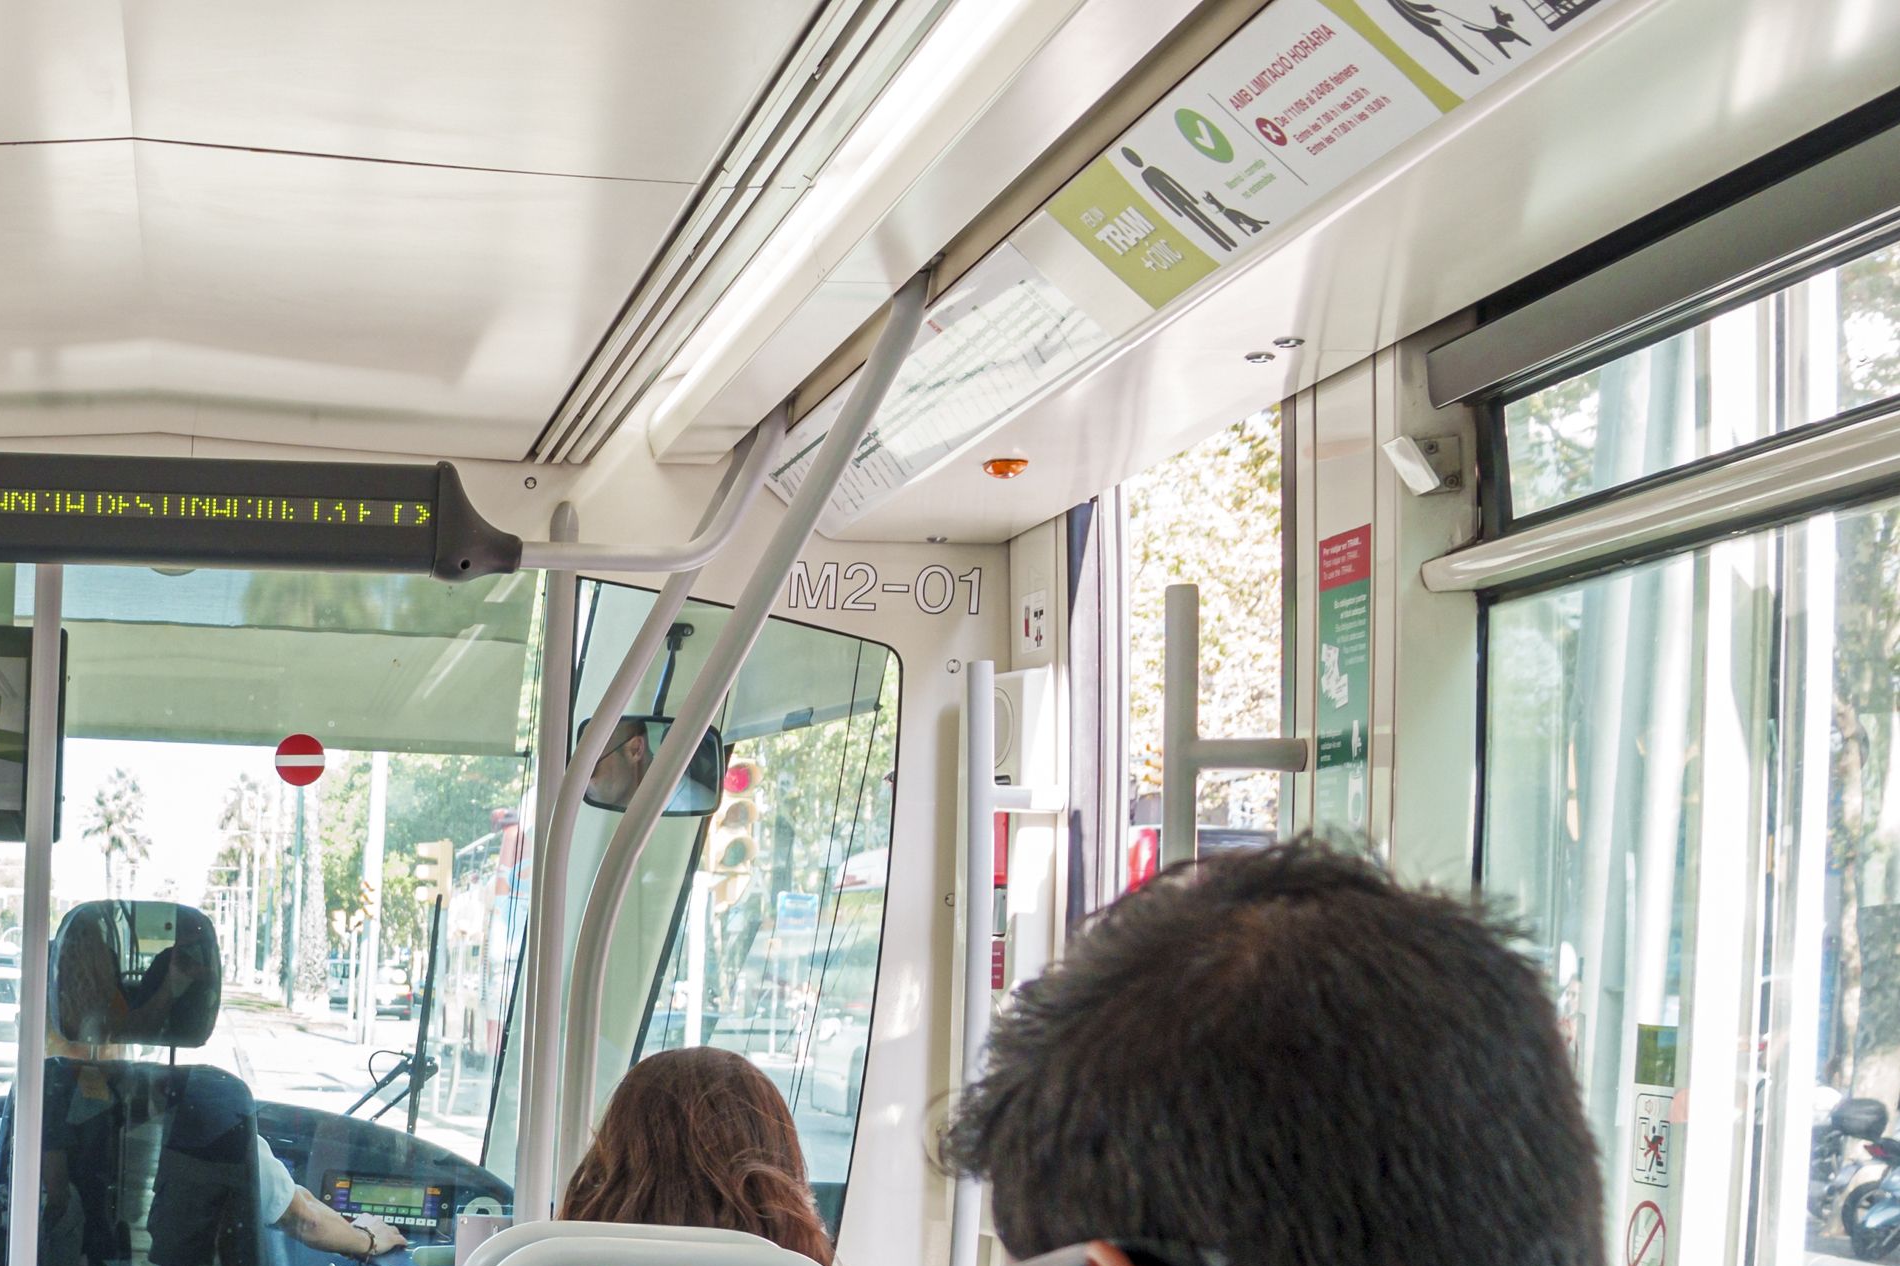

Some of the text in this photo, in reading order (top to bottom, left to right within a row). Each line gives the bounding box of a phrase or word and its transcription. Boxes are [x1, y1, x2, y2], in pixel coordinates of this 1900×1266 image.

[1229, 24, 1336, 112] AMB LIMITACIÓ HORÀRIA
[1094, 206, 1156, 255] TRAM
[788, 560, 982, 615] M2-01
